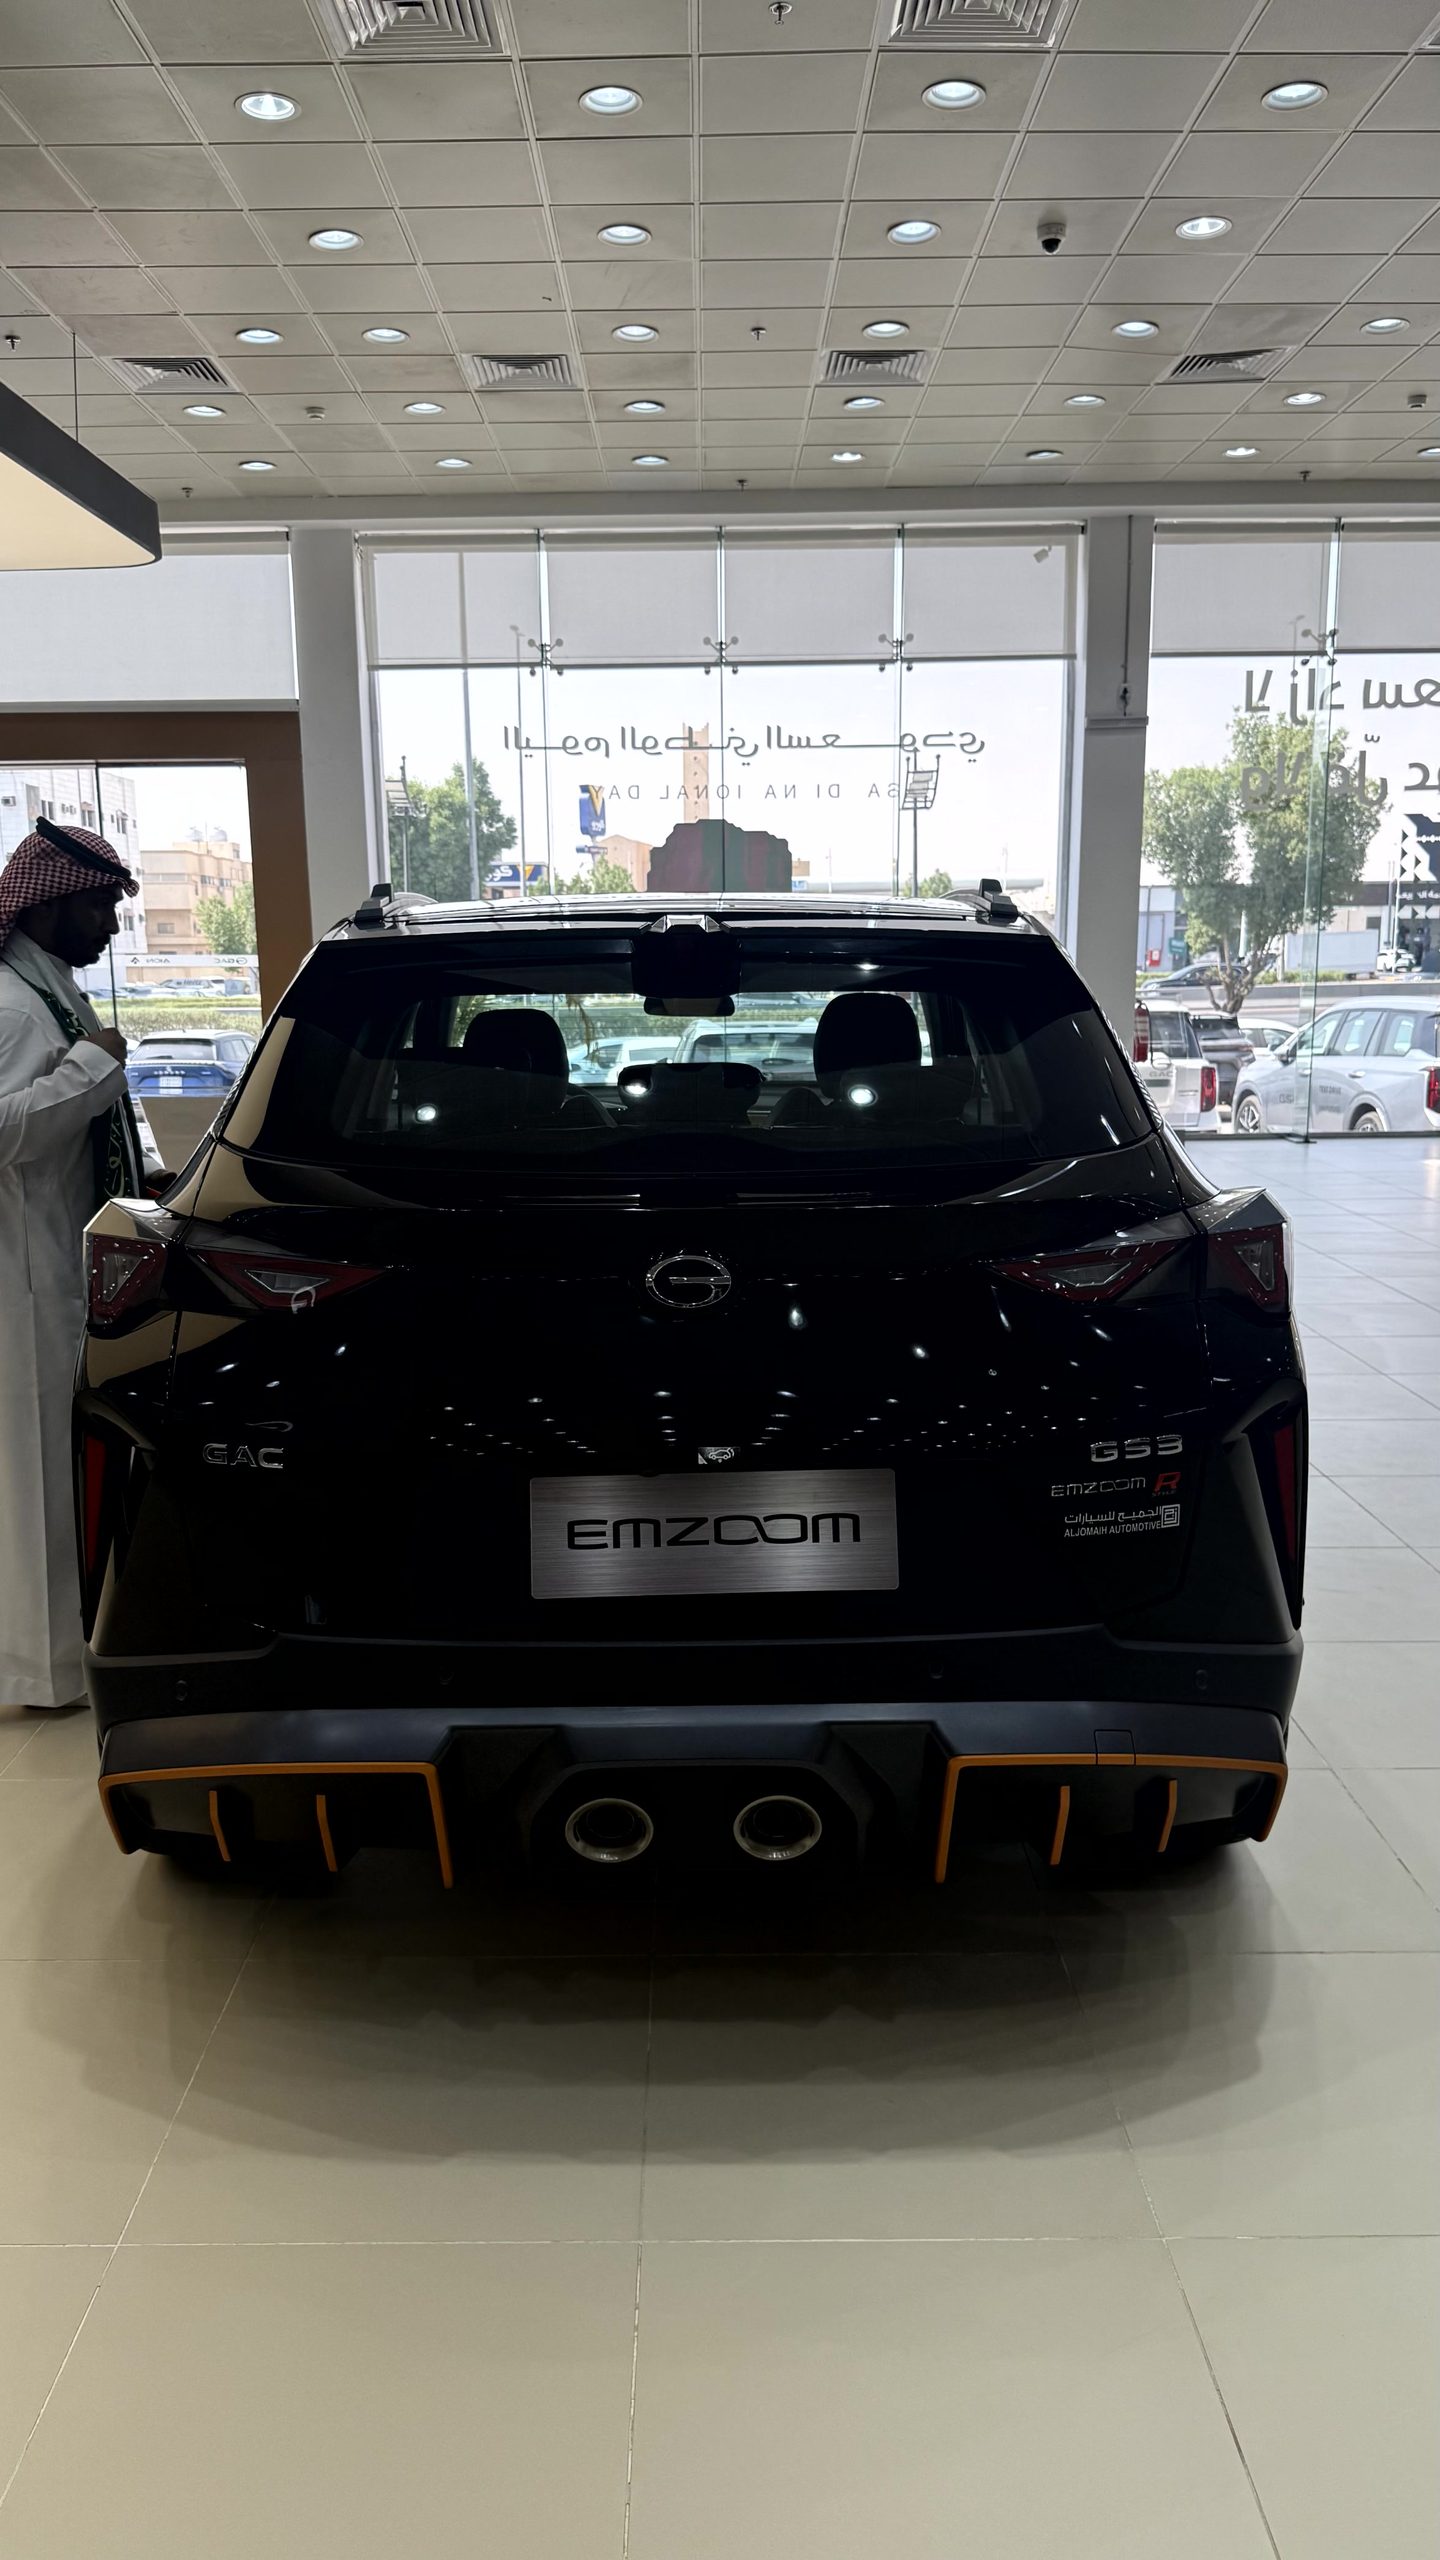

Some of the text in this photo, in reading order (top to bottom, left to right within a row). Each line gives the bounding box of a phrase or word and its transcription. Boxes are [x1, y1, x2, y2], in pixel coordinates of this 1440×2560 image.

[203, 1443, 284, 1468] GAC
[1090, 1434, 1183, 1462] GS3
[1051, 1471, 1181, 1497] EMZOOM R
[1064, 1505, 1162, 1525] الجميح للسيارات
[567, 1512, 861, 1550] EMZOOM
[1064, 1520, 1161, 1538] ALJOMAIH AUTOMOTIVE
